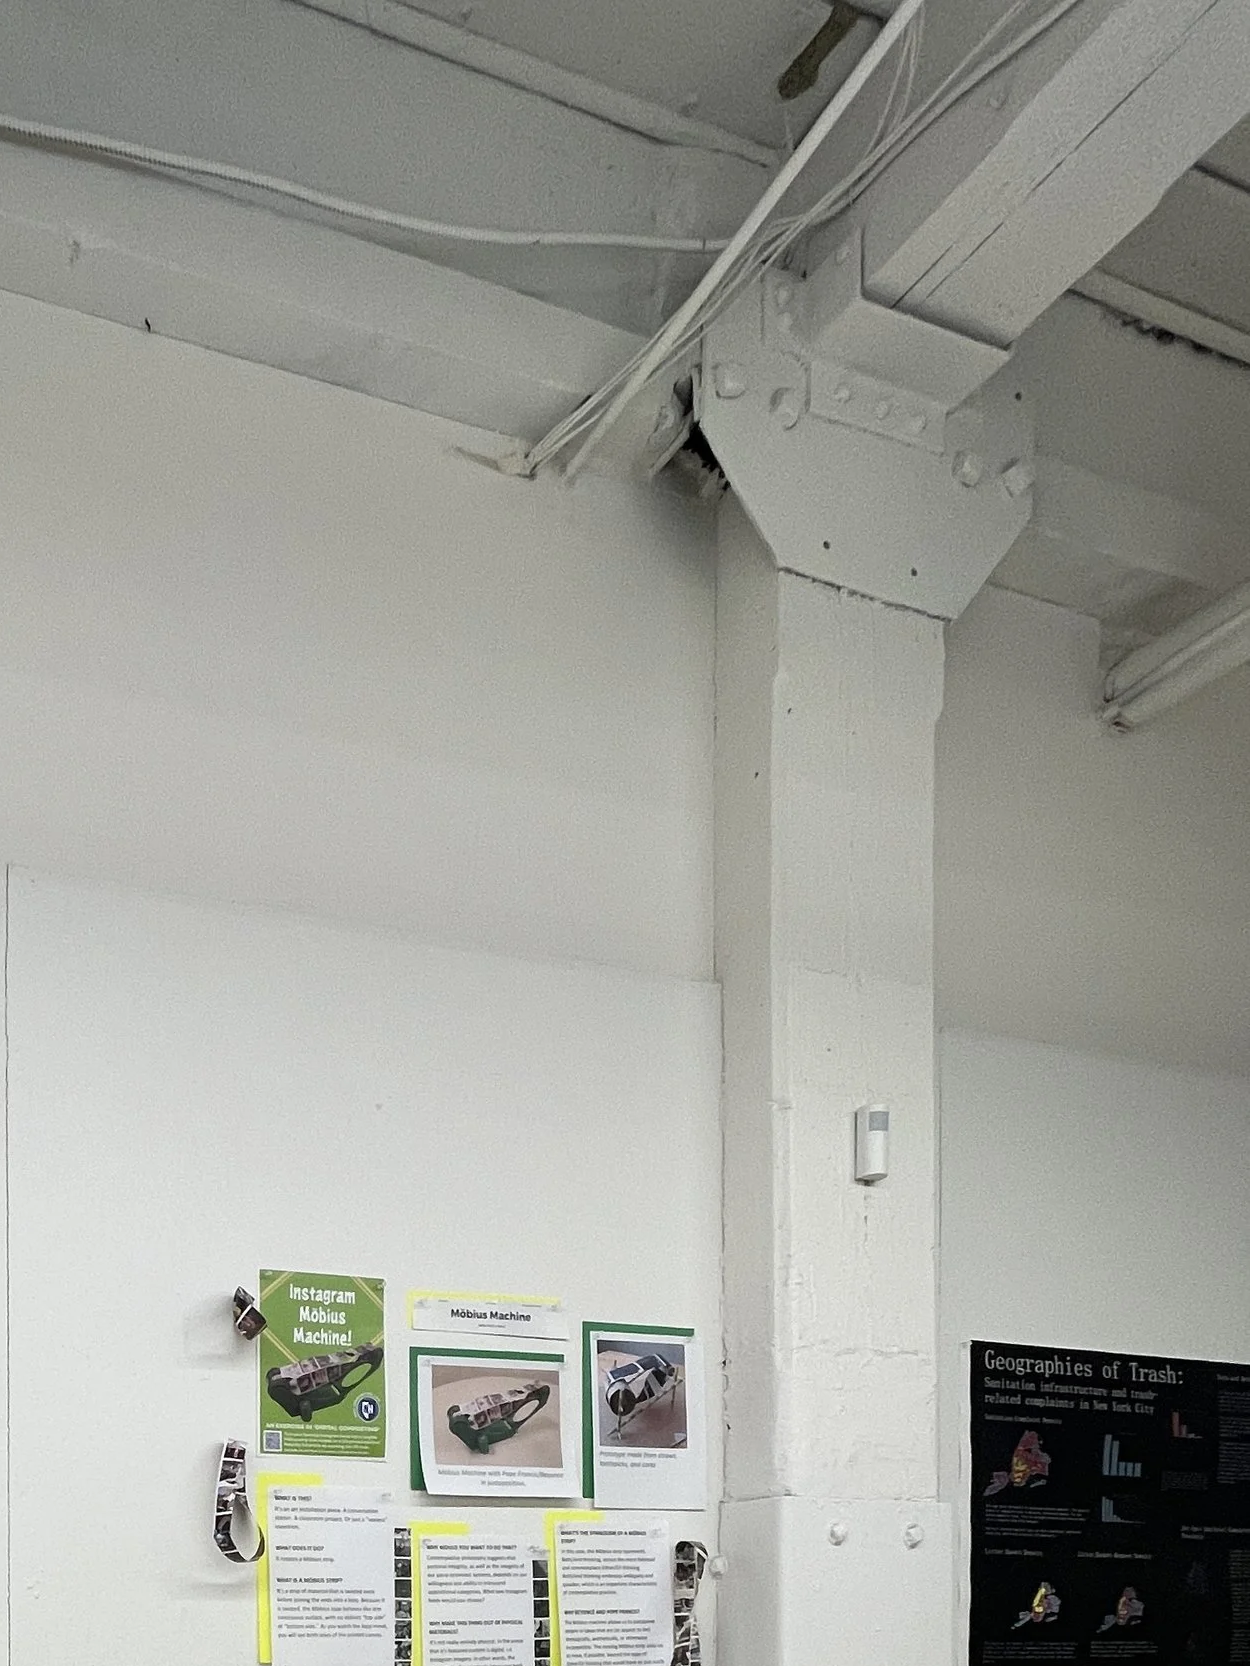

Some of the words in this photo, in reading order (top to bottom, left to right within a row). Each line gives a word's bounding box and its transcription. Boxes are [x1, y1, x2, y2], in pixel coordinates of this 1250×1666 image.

[289, 1283, 355, 1305] Instagram
[299, 1306, 346, 1325] Möbius
[450, 1308, 487, 1320] Möbius
[489, 1310, 531, 1322] Machine
[293, 1327, 352, 1347] Machine!
[984, 1350, 1092, 1377] Geographies
[1102, 1361, 1121, 1380] of
[1128, 1362, 1183, 1384] Trash:
[984, 1377, 1036, 1390] Sanitation
[1111, 1388, 1126, 1397] and
[984, 1393, 1021, 1404] related
[1079, 1400, 1089, 1409] in
[1093, 1400, 1108, 1410] New
[1112, 1401, 1131, 1412] York
[1134, 1403, 1154, 1413] City
